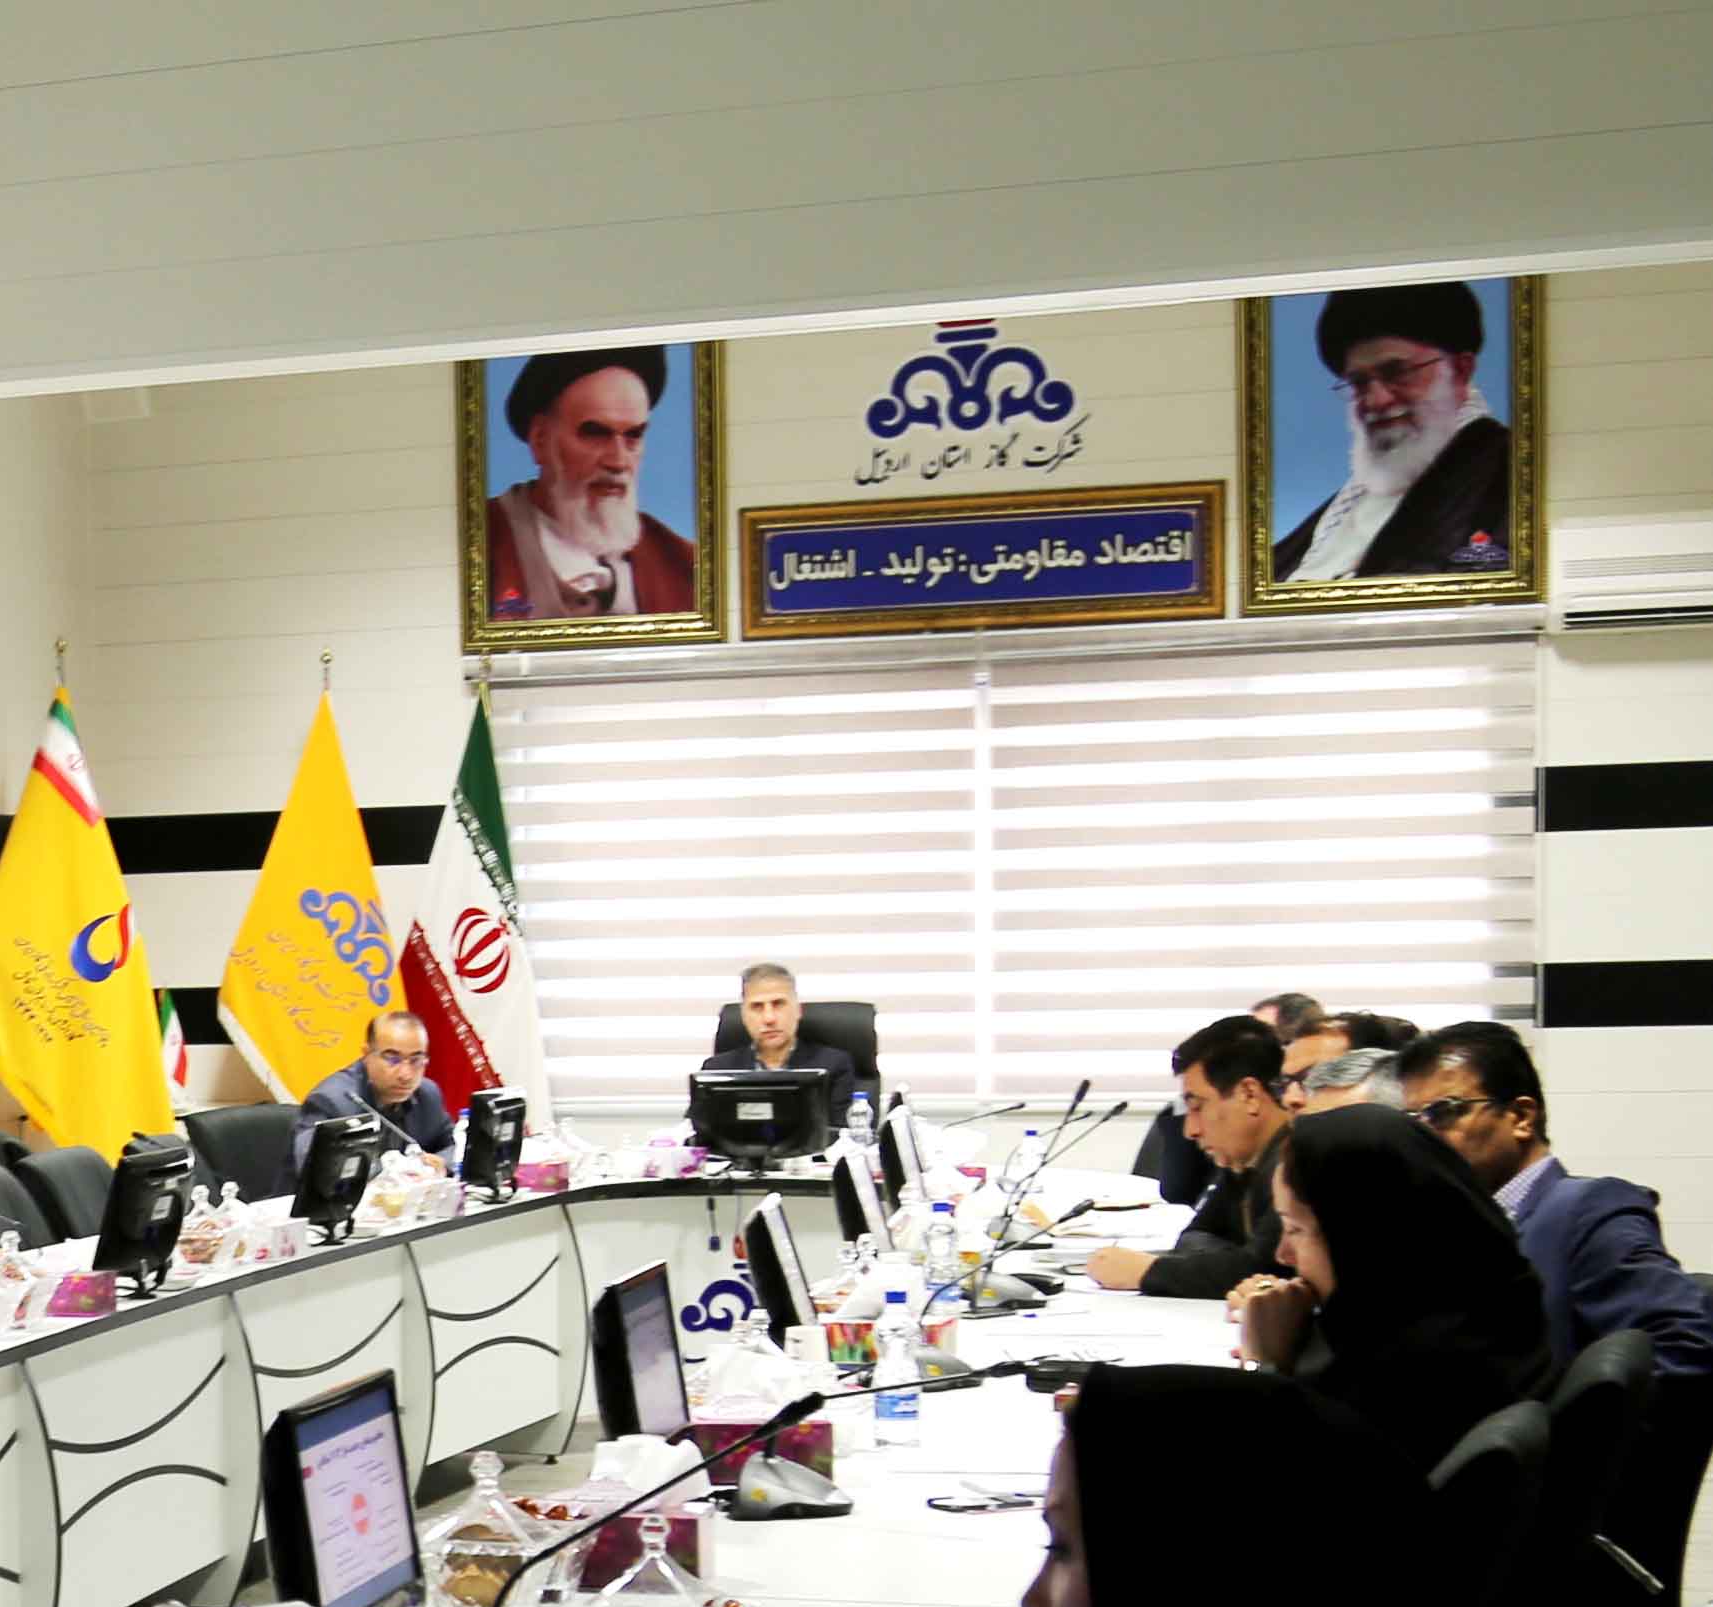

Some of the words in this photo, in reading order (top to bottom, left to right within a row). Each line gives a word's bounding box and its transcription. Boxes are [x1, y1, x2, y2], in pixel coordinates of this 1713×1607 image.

[920, 444, 972, 481] استان
[984, 431, 1021, 470] گاز
[1022, 413, 1091, 474] شرکت
[879, 544, 956, 588] تولید
[1093, 529, 1194, 566] اقتصاد
[767, 547, 857, 590] اشتغال
